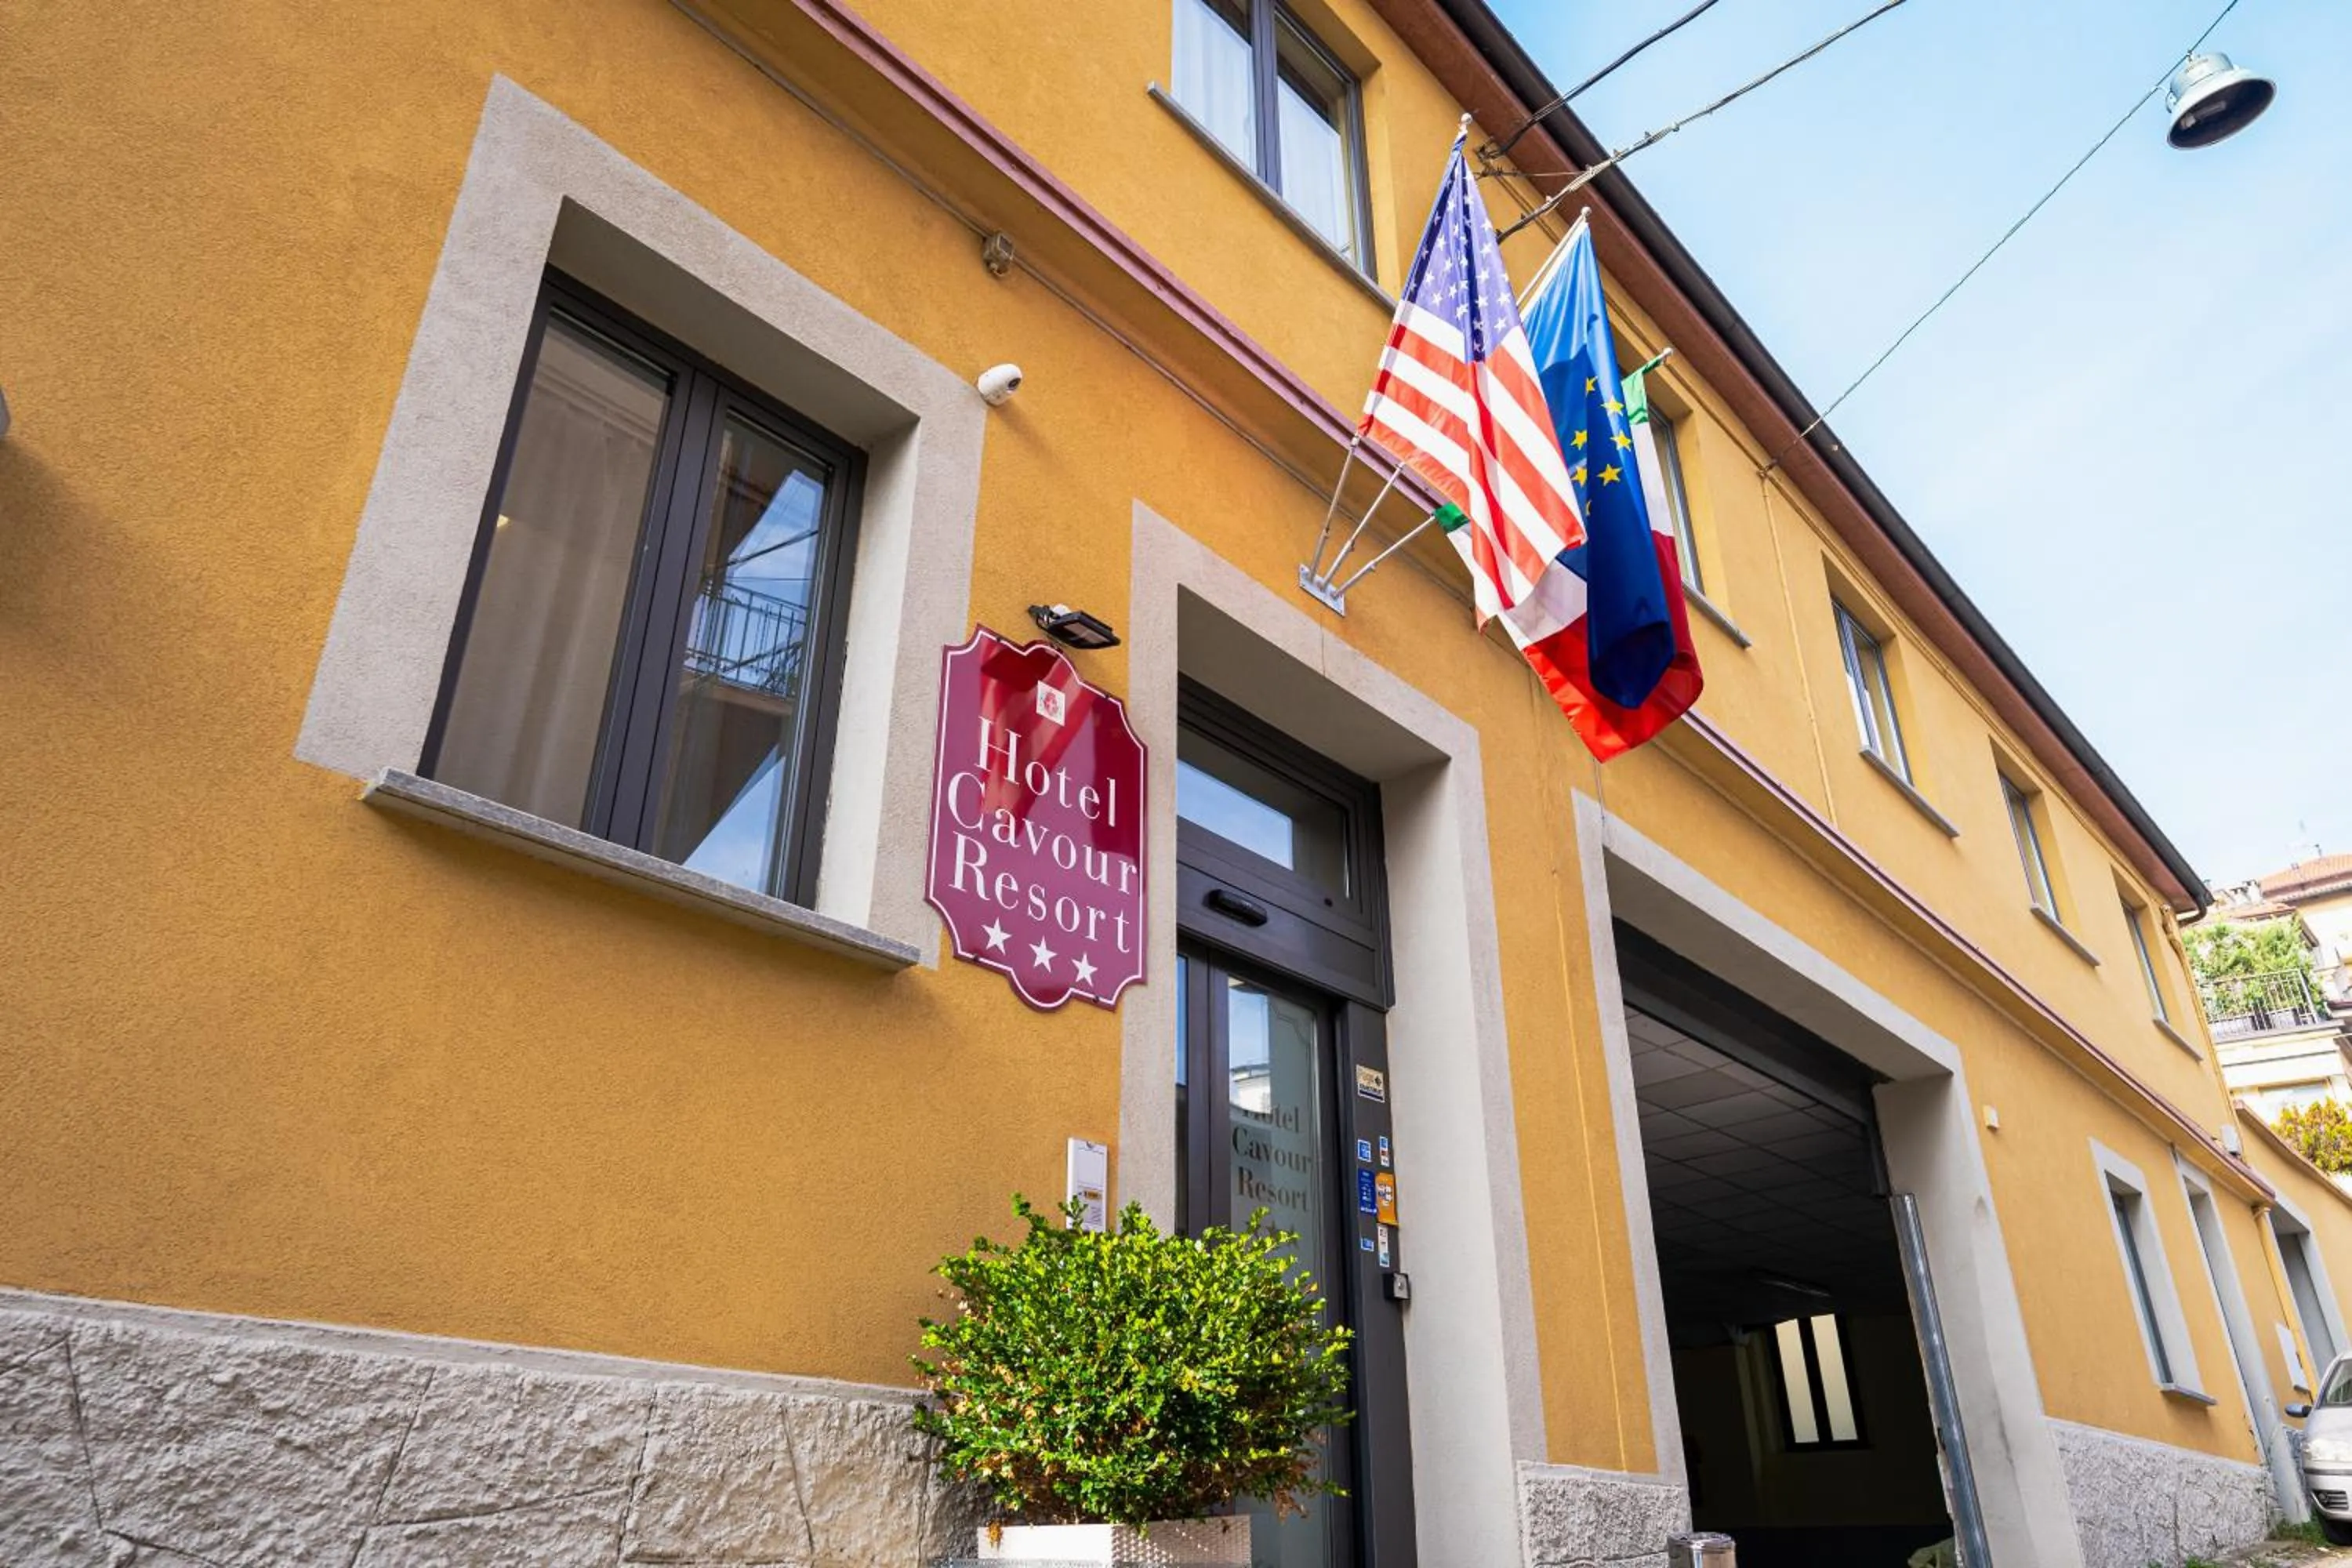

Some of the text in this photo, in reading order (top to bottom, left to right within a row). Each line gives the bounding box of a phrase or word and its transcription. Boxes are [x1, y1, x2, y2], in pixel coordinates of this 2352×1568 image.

[974, 715, 1116, 828] Hotel
[947, 771, 1138, 895] Cavour
[948, 830, 1131, 954] Resort
[1232, 1123, 1312, 1174] Cavour
[1241, 1103, 1300, 1133] otel
[1237, 1166, 1309, 1212] Resort
